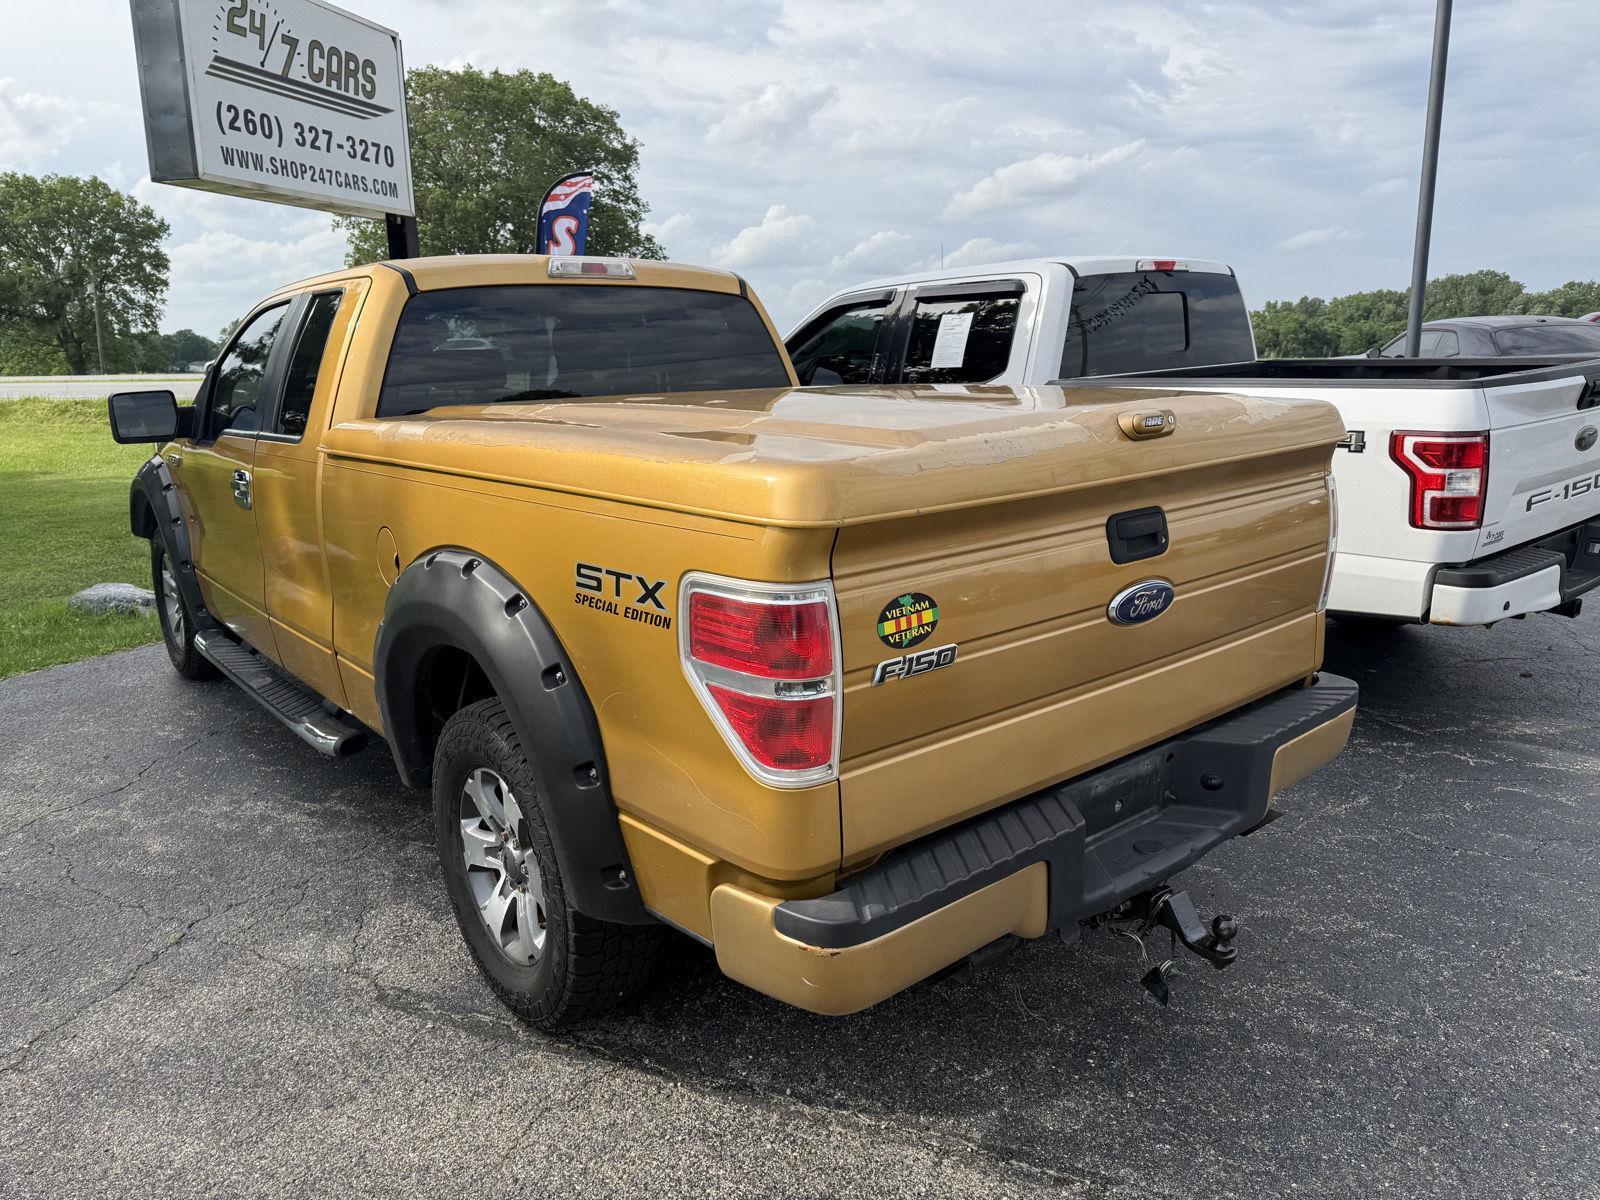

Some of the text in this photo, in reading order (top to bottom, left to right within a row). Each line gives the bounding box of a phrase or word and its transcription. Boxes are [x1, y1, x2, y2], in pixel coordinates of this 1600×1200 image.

[307, 39, 377, 99] CARS
[216, 101, 395, 168] (260) 327-3270
[220, 146, 398, 199] WWW.SHOP247CARS.COM
[576, 562, 666, 610] STX
[1129, 589, 1166, 618] Ford
[575, 592, 672, 629] SPECIAL EDITION
[886, 600, 930, 619] VIETNAM
[888, 624, 932, 644] VETERAN
[872, 643, 958, 687] F-150
